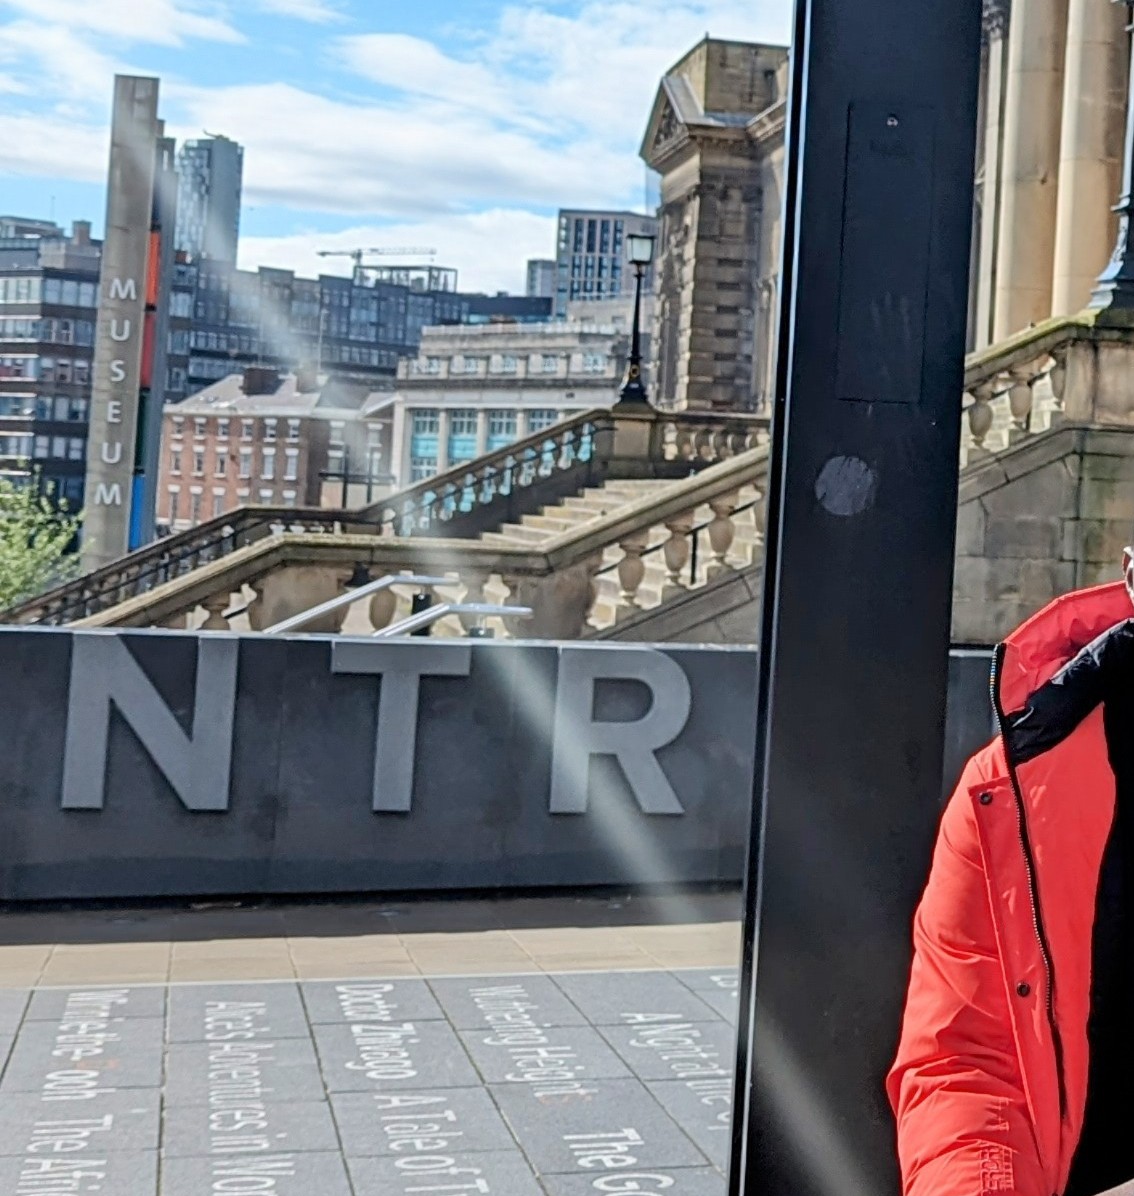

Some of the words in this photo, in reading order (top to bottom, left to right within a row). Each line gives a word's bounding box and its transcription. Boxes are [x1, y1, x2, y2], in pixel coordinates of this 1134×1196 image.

[94, 277, 137, 507] MUSEUM
[205, 1000, 271, 1041] Alice's
[334, 983, 398, 1023] Doctor
[344, 1022, 421, 1080] Zhivago
[620, 1012, 683, 1024] A
[670, 1062, 733, 1078] at
[208, 1042, 276, 1133] Adventures
[468, 984, 552, 1046] Wuthering
[563, 1127, 645, 1168] The
[373, 1094, 448, 1109] A
[26, 1113, 114, 1153] The
[210, 1132, 287, 1153] in
[380, 1109, 463, 1152] Tale
[393, 1154, 481, 1176] of
